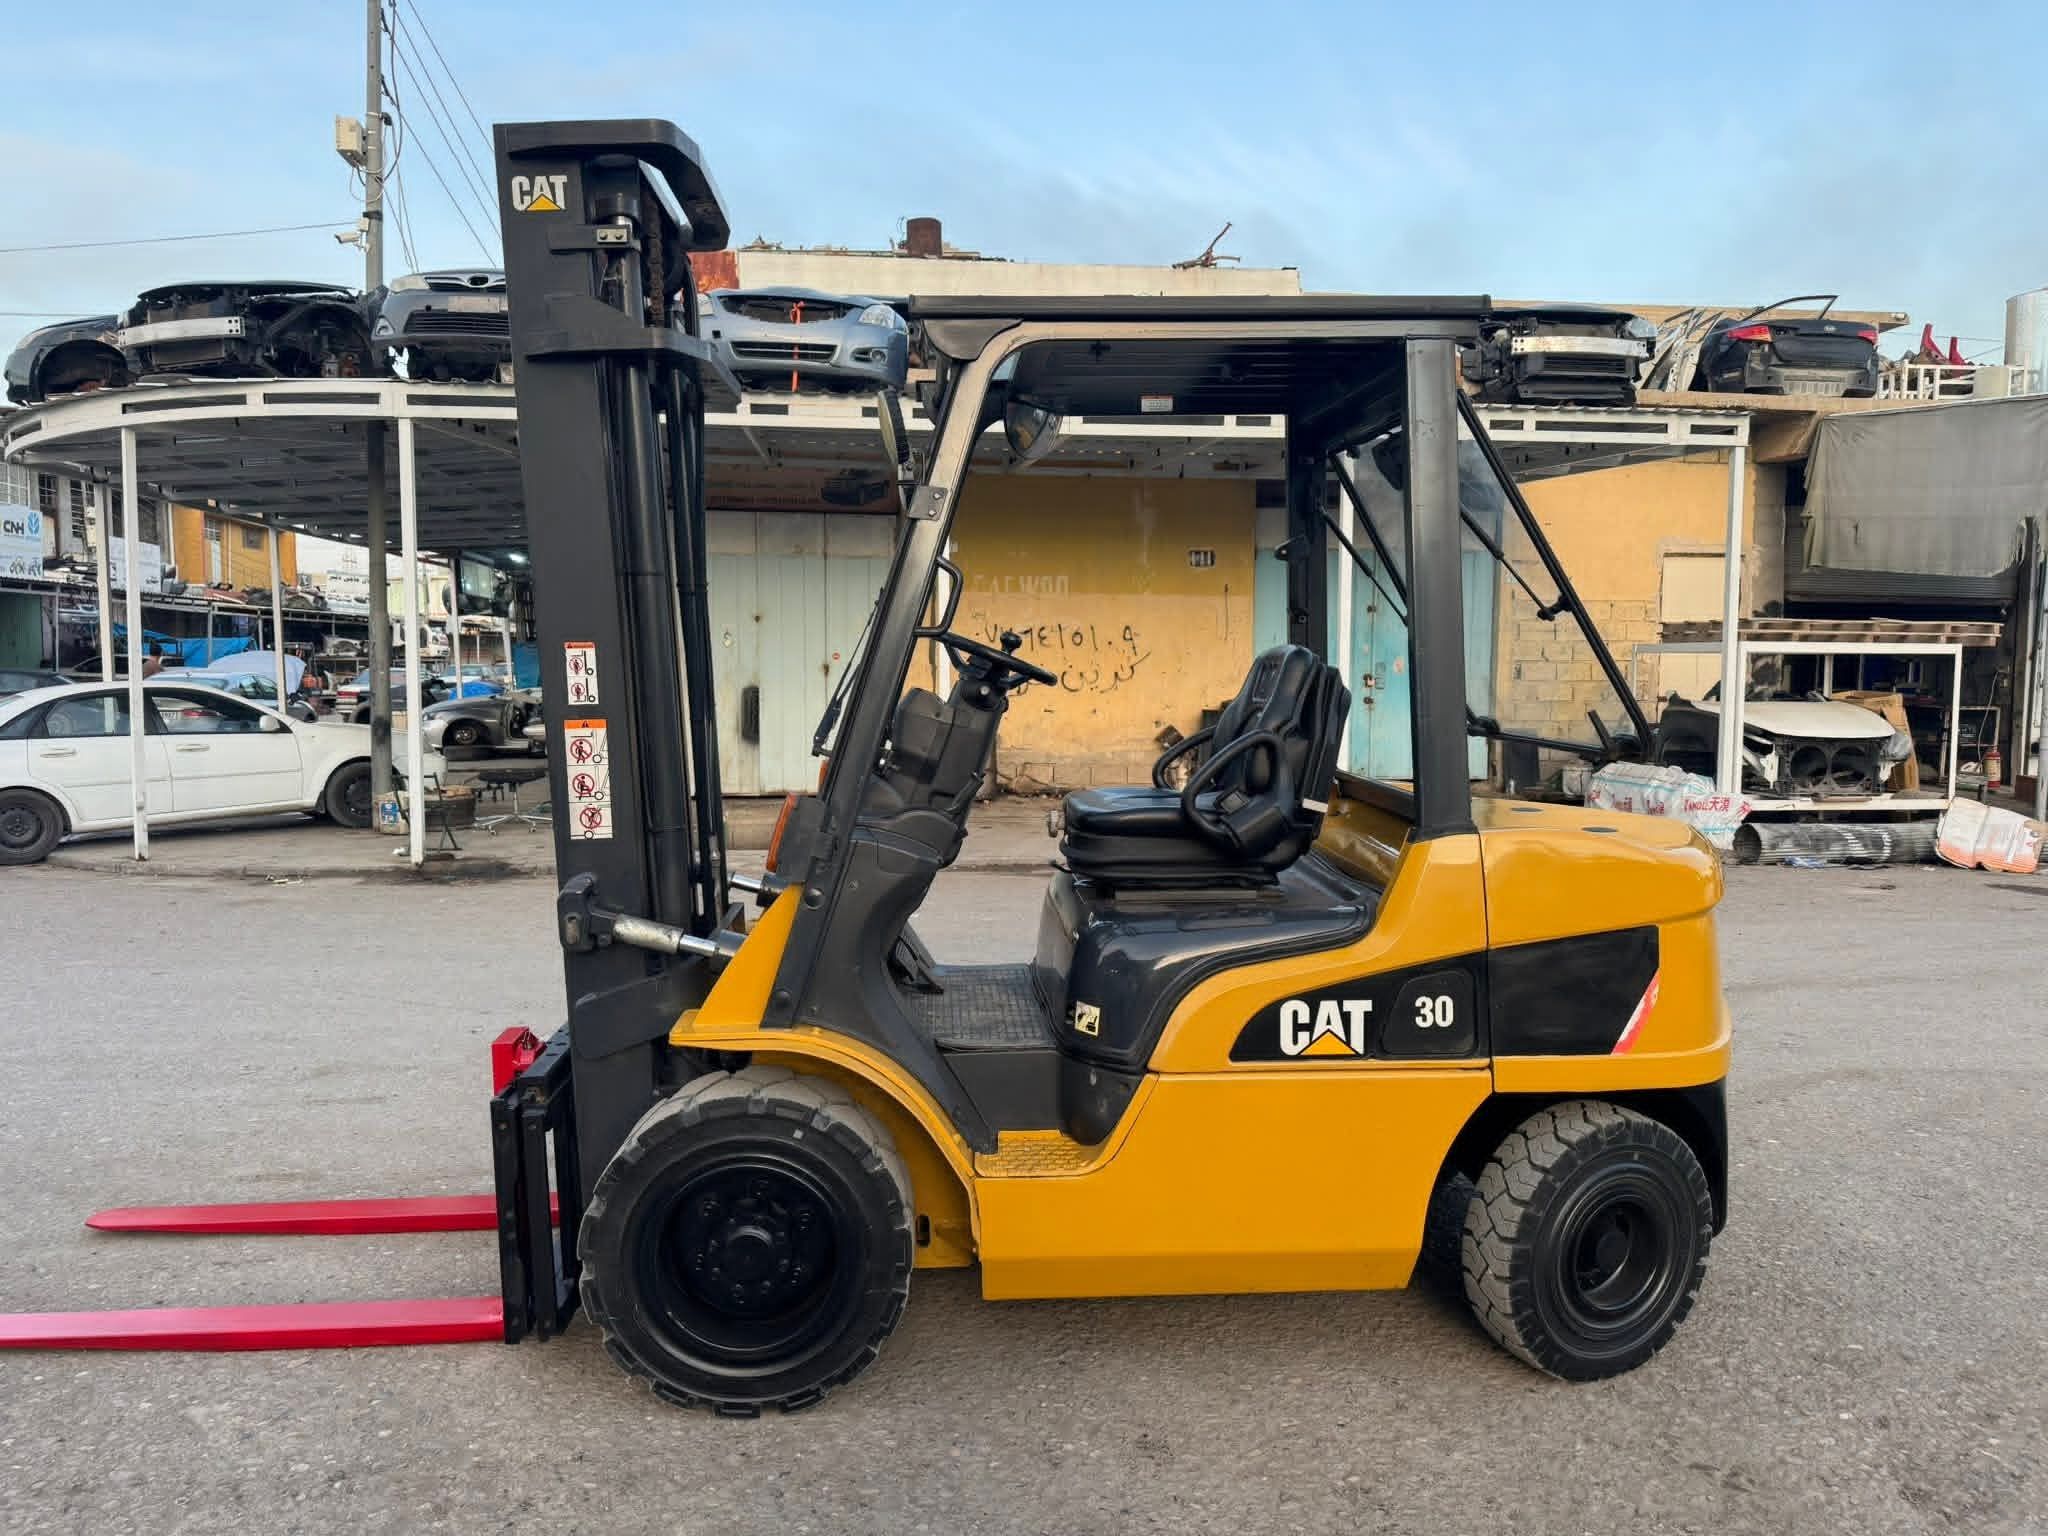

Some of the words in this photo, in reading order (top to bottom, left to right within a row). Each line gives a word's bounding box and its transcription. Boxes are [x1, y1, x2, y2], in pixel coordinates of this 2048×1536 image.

[511, 175, 568, 212] CAT
[1279, 999, 1373, 1056] CAT
[1415, 995, 1454, 1029] 30
